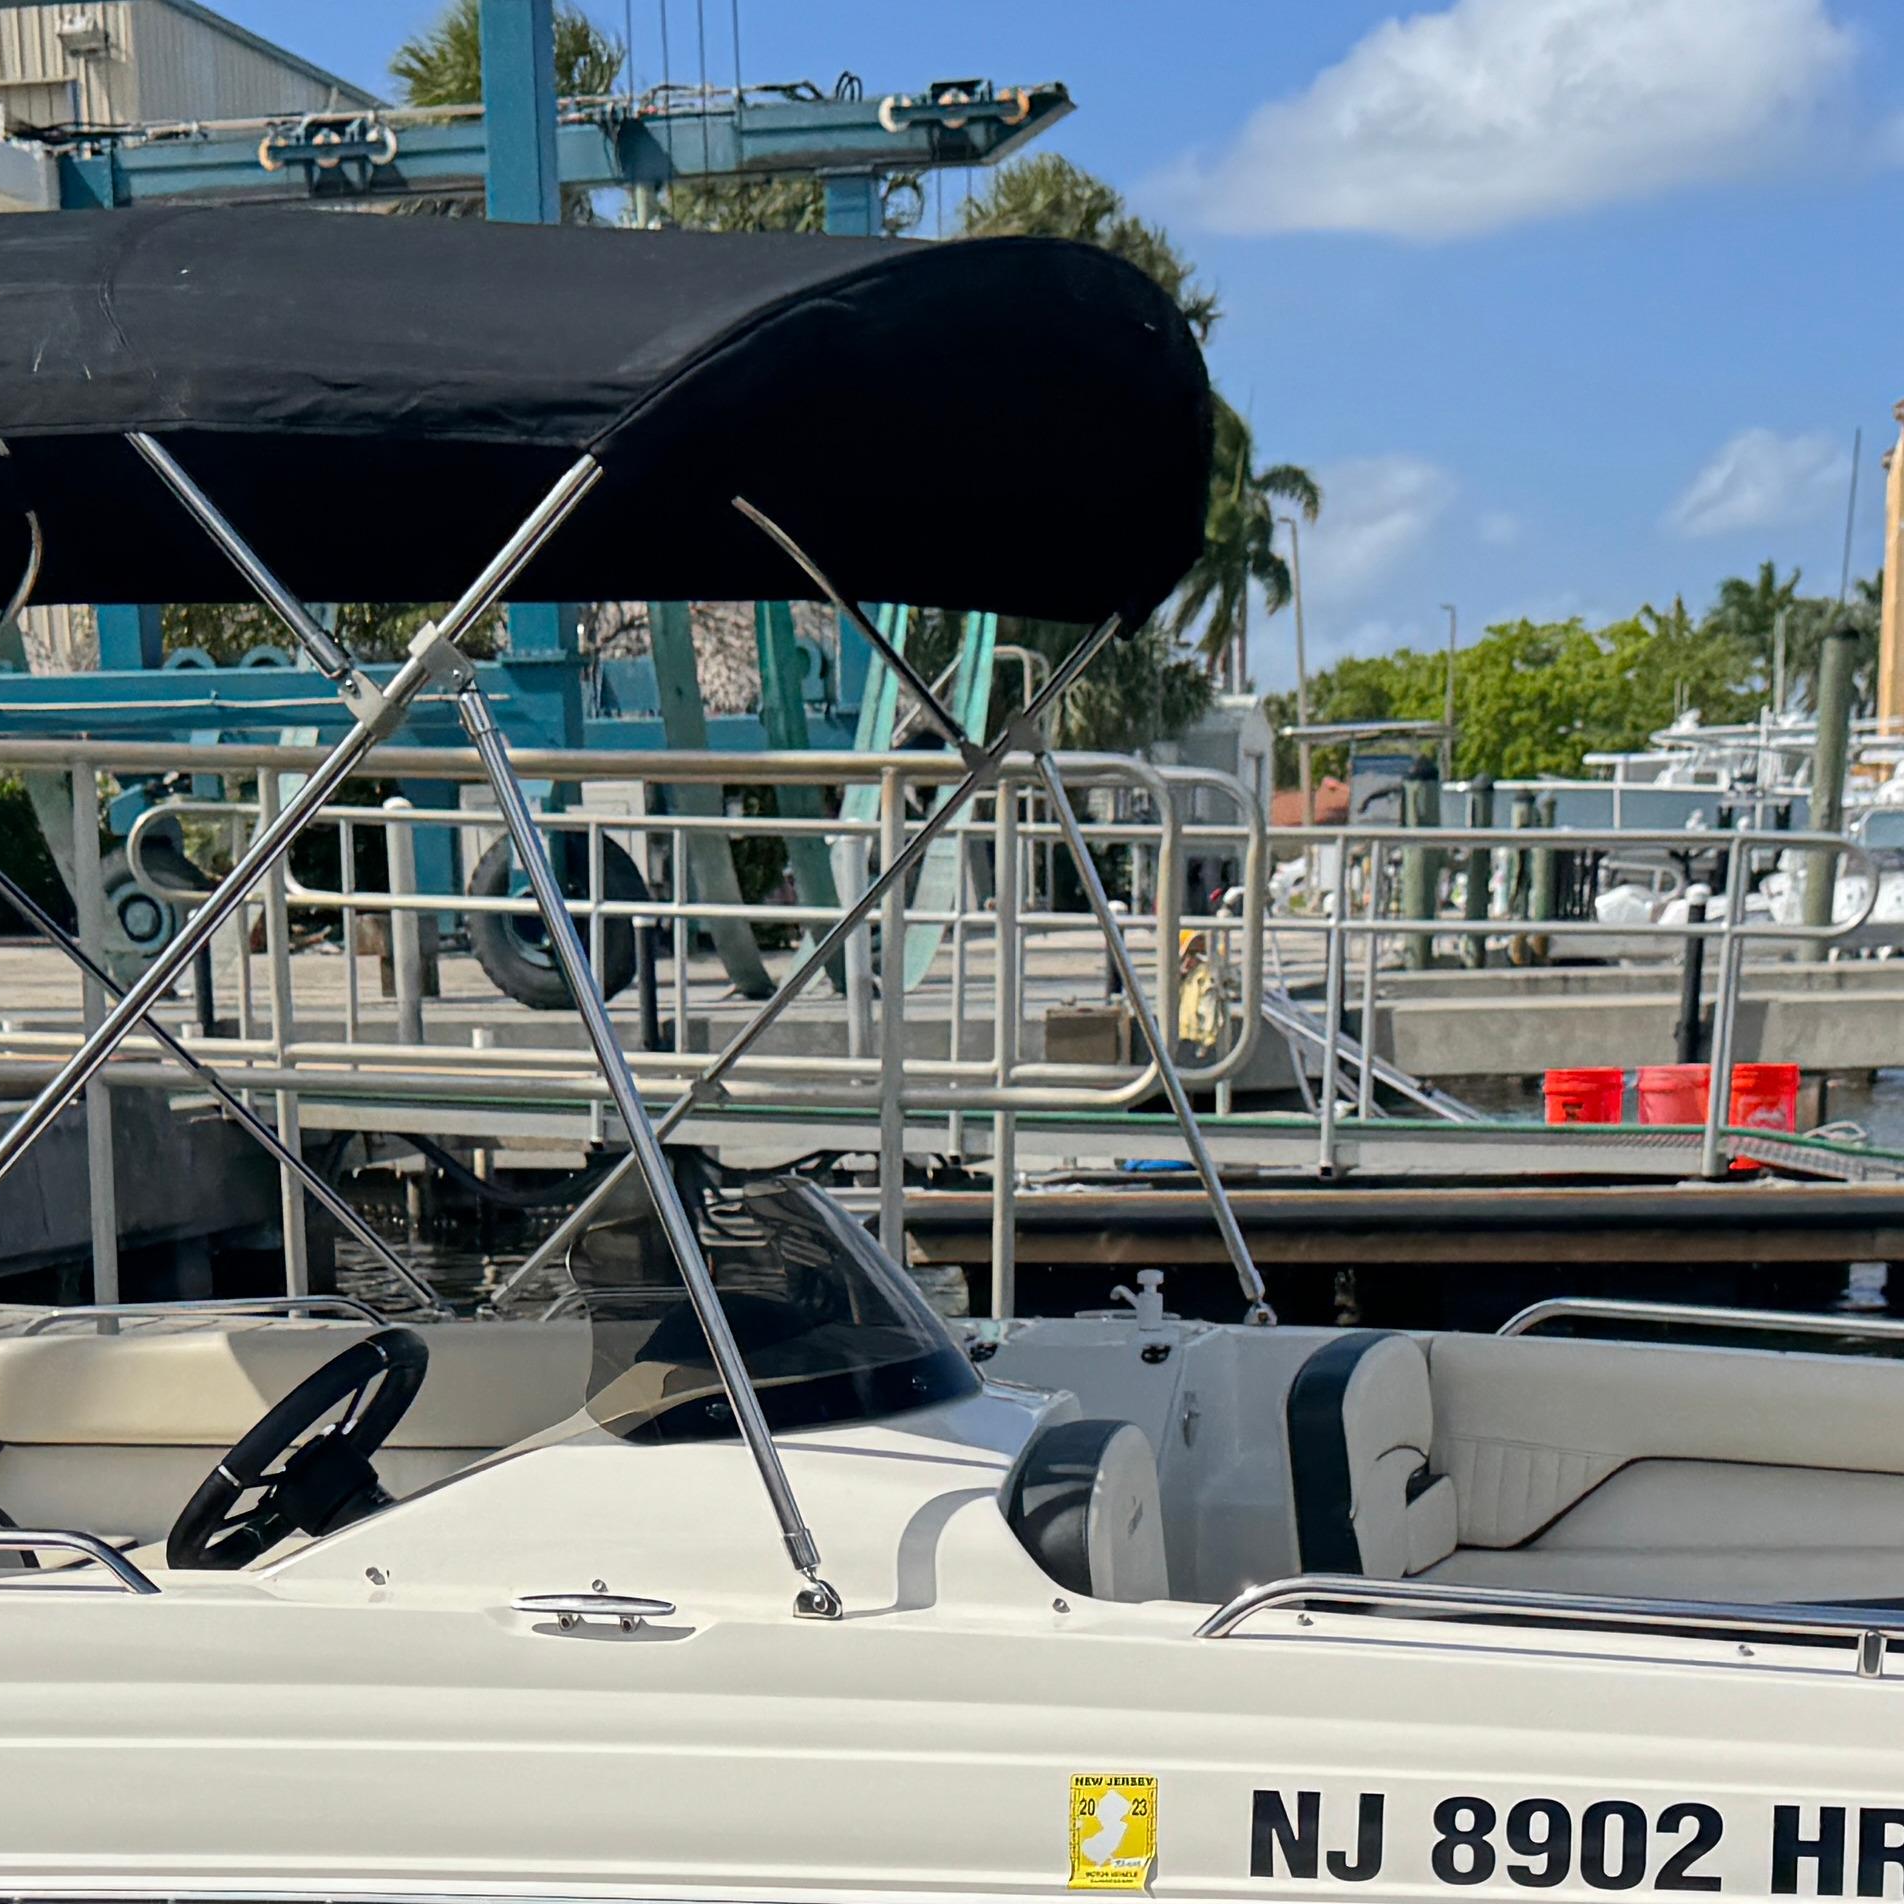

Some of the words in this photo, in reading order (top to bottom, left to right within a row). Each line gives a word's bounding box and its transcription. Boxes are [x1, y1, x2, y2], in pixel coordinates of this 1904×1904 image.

[1075, 1777, 1104, 1787] NEW
[1106, 1777, 1154, 1787] JERSEY
[1079, 1797, 1096, 1816] 20
[1131, 1798, 1148, 1816] 23
[1250, 1789, 1386, 1882] NJ
[1431, 1796, 1724, 1892] 8902
